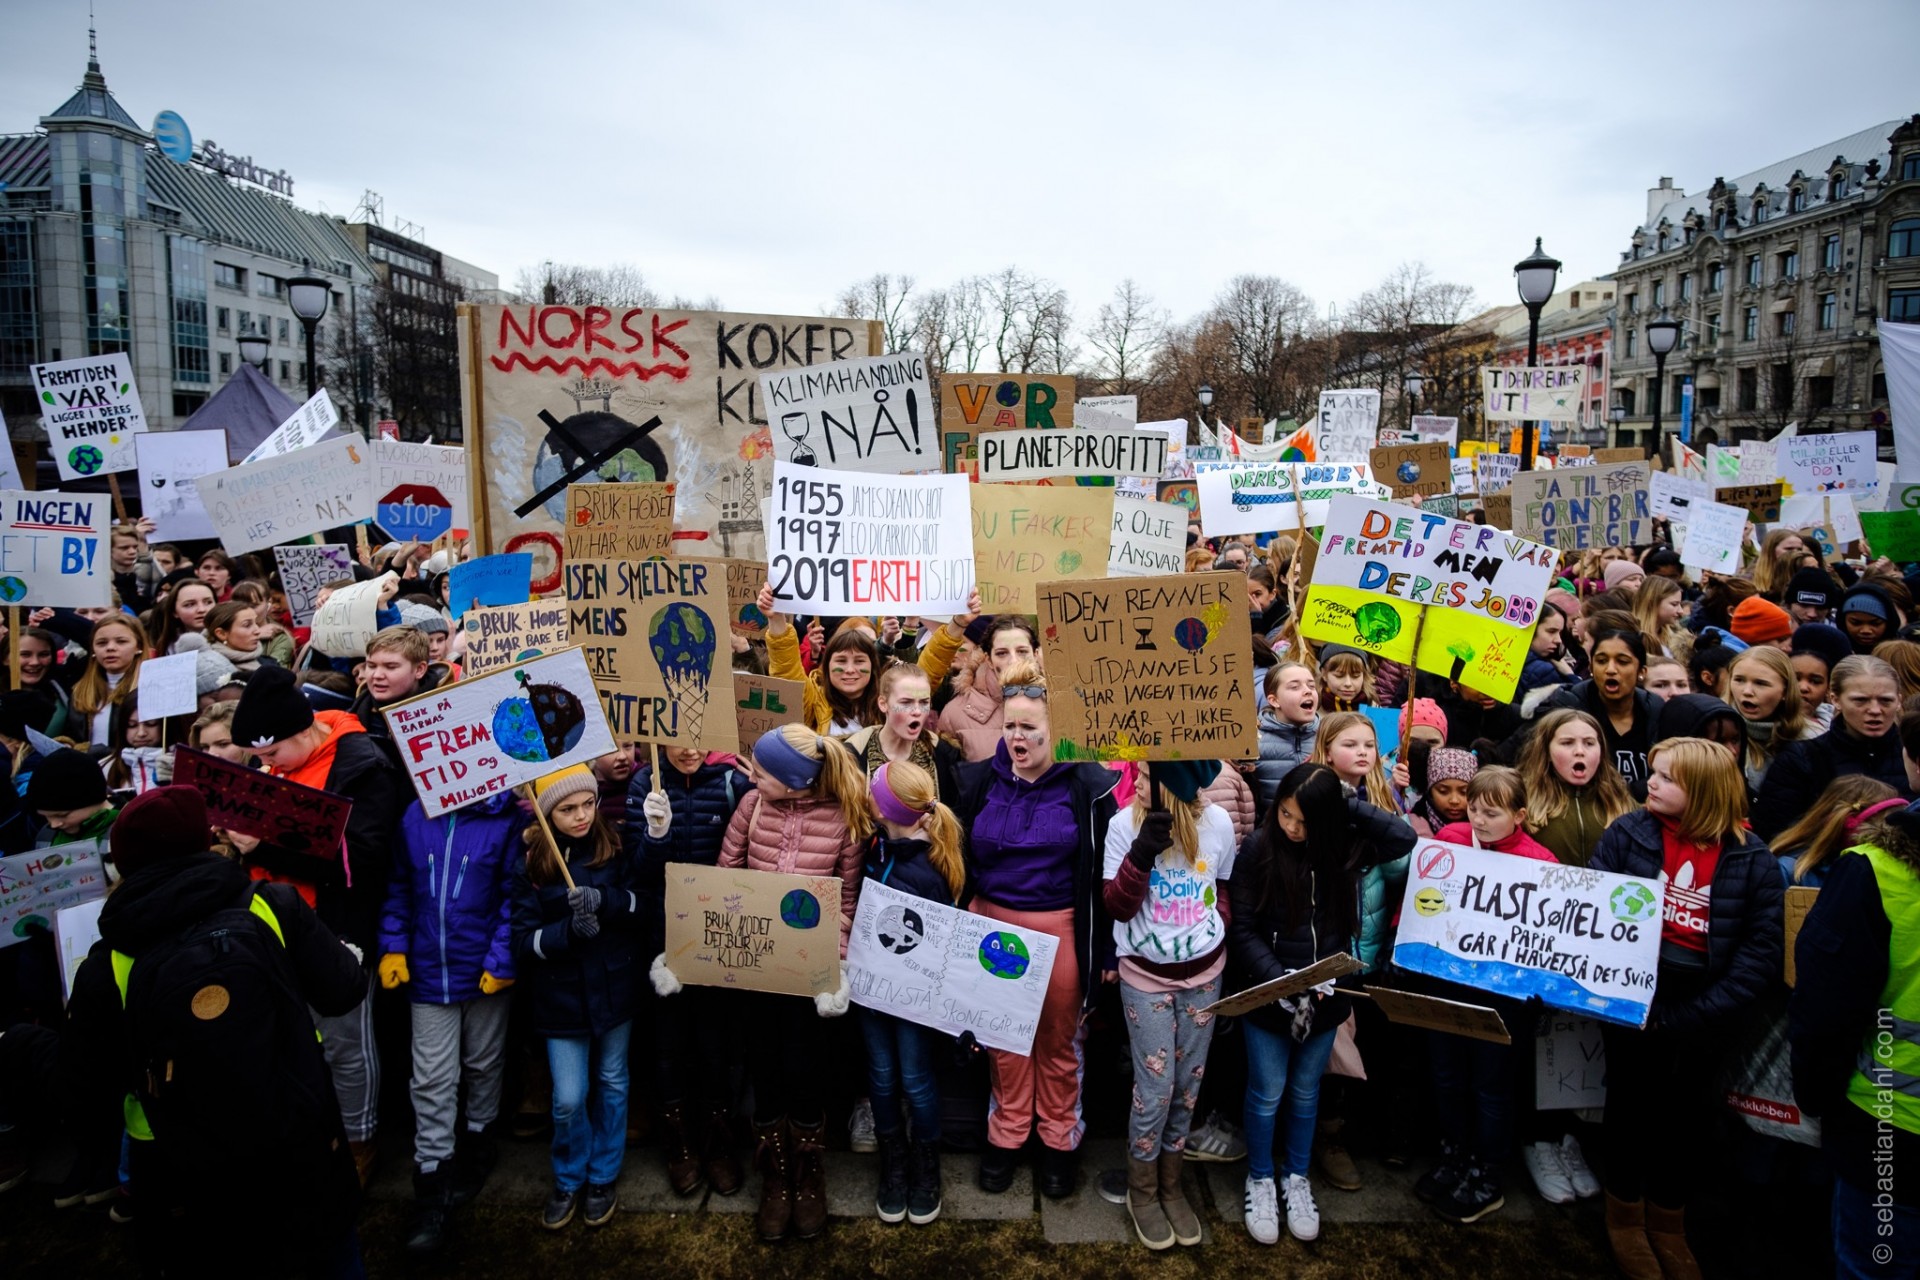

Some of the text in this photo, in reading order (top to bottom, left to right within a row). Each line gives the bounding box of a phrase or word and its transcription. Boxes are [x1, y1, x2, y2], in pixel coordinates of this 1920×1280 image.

[202, 139, 294, 197] Statkraft
[500, 305, 691, 361] NORSK
[36, 363, 117, 388] FREMTIDEN
[769, 358, 923, 407] KLIMAHANDLING
[51, 404, 131, 424] LIGGER DERES
[1324, 397, 1372, 410] MAKE
[821, 388, 922, 465] NÅ!
[1321, 410, 1377, 433] EARTH
[1380, 430, 1400, 440] SEX
[375, 442, 433, 465] HVORFOR
[1319, 434, 1374, 455] GREAT
[1788, 434, 1836, 447] HA BRA
[1790, 444, 1861, 460] MILJØ ELLER
[1373, 446, 1447, 469] GI OSS EN
[1793, 455, 1856, 467] VERDEN VIL
[380, 467, 402, 487] EN
[1535, 475, 1601, 500] JA TIL
[574, 488, 621, 527] BRUK
[778, 475, 844, 517] 1955
[926, 487, 944, 519] HOT
[1526, 489, 1650, 530] FORNYBAR
[17, 499, 93, 527] INGEN
[388, 502, 442, 527] STOP
[1010, 508, 1095, 540] FAKKER
[1131, 509, 1174, 539] OLJE
[245, 519, 279, 542] HER
[777, 515, 841, 555] 1997
[842, 522, 867, 555] LEO
[922, 524, 940, 556] HOT
[1360, 509, 1554, 569] DET ER VÅR
[61, 536, 98, 576] B!
[568, 532, 672, 559] VI HAR KUN EN
[1118, 541, 1180, 572] ANSVAR
[996, 550, 1045, 575] MED
[1434, 549, 1503, 585] MEN
[566, 562, 709, 602] ISEN SMELTER
[772, 554, 850, 603] 2019
[852, 559, 921, 603] EARTH
[945, 558, 973, 601] HOT
[1040, 581, 1232, 624] TIDEN RENNER
[1358, 561, 1538, 626] DERES JOBB
[479, 612, 523, 637] BRUK
[570, 607, 627, 637] MENS
[494, 633, 552, 653] HAR BARE
[1076, 653, 1236, 685] UTDANNELSE
[1083, 688, 1114, 708] HAR
[1227, 679, 1242, 701] Å
[392, 698, 452, 723] TENK PÅ
[401, 713, 444, 733] BARNAS
[1086, 708, 1234, 733] SI NÅR VI IKKE
[1086, 730, 1118, 749] HAR
[1128, 731, 1162, 747] NOE
[414, 760, 468, 791] TID
[195, 761, 341, 820] DET ER VÅR
[440, 774, 508, 809] MILJØET
[1166, 869, 1186, 878] The
[1159, 877, 1203, 900] Daily
[1152, 897, 1205, 927] Mile
[1460, 874, 1640, 943] PLAST SØPPEL OG
[704, 911, 732, 934] BRUK
[736, 915, 773, 936] HODET
[704, 930, 775, 955] DET BLIR VÅR
[717, 950, 762, 968] KLODE
[1458, 931, 1497, 957] GÅR
[1593, 964, 1619, 984] DET
